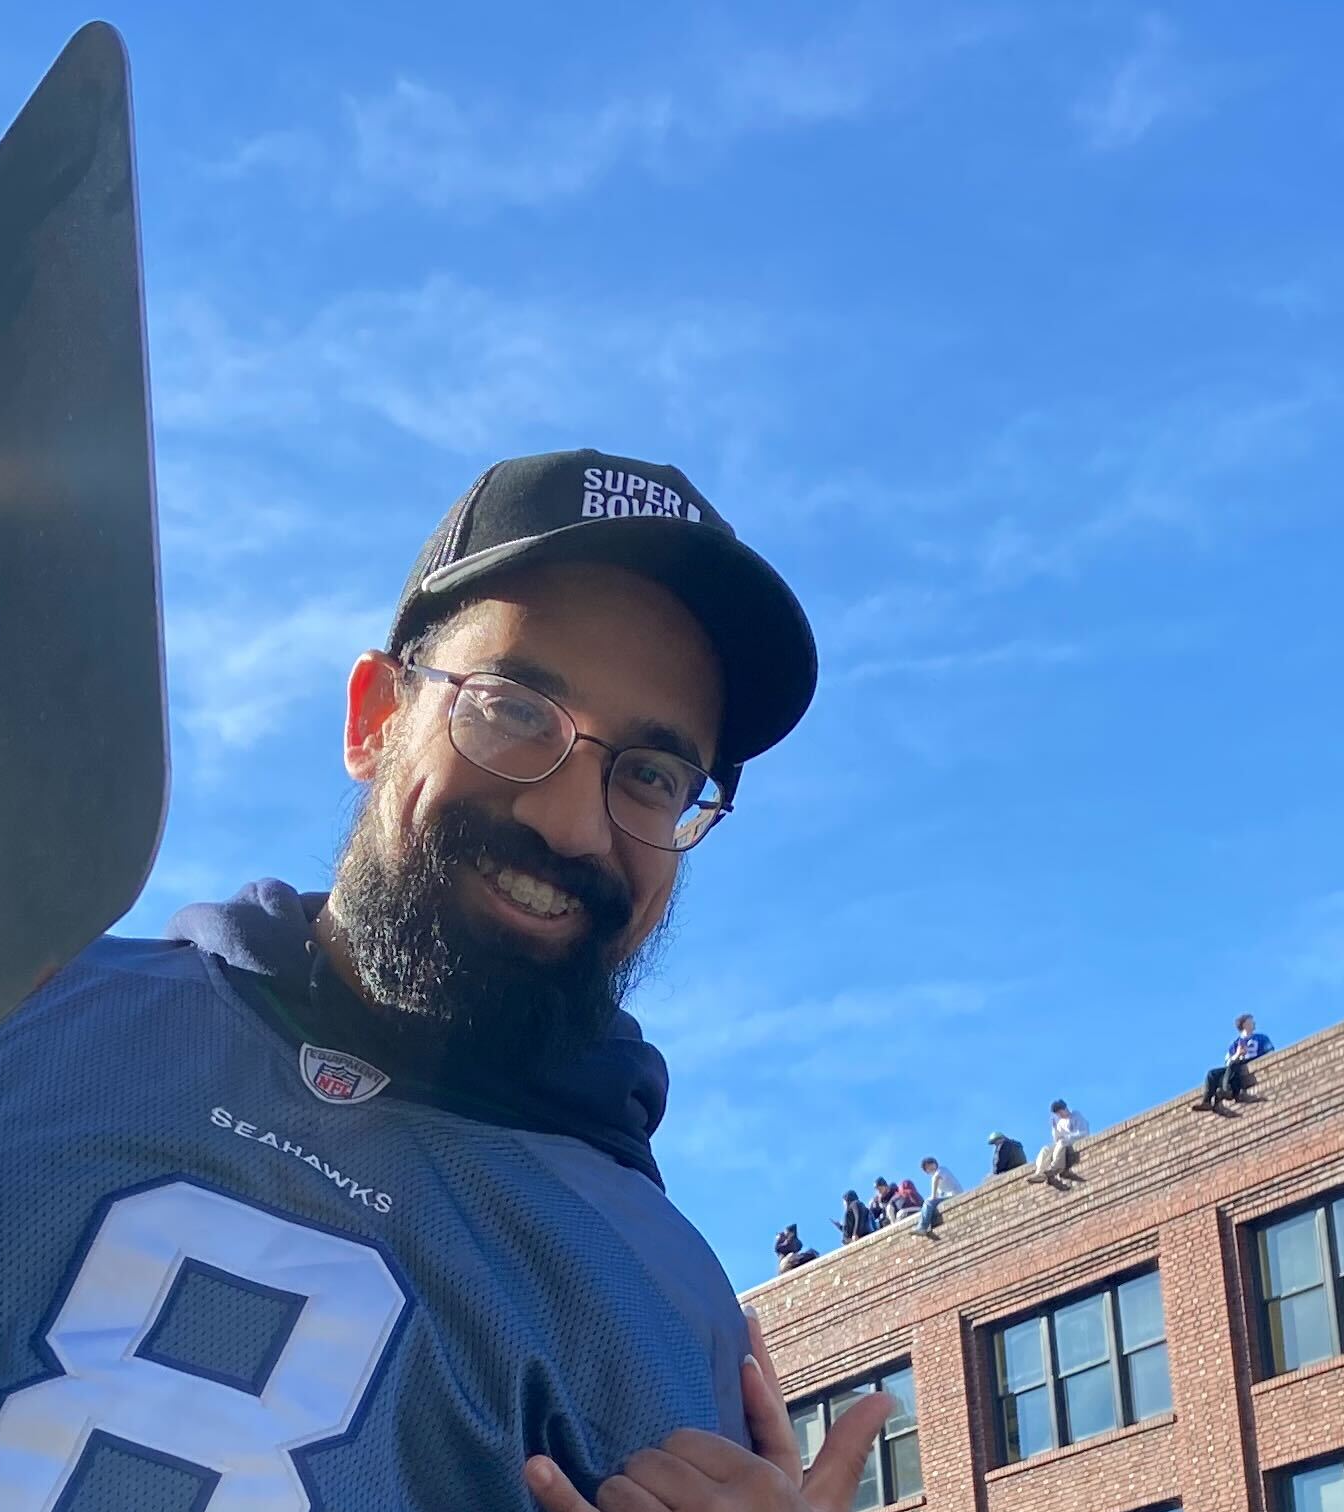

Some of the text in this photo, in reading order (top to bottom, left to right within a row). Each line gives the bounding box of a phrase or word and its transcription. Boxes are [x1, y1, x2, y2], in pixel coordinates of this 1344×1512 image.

[581, 490, 673, 519] BOW
[583, 468, 682, 519] SUPER
[210, 1106, 393, 1214] SEAHAWKS
